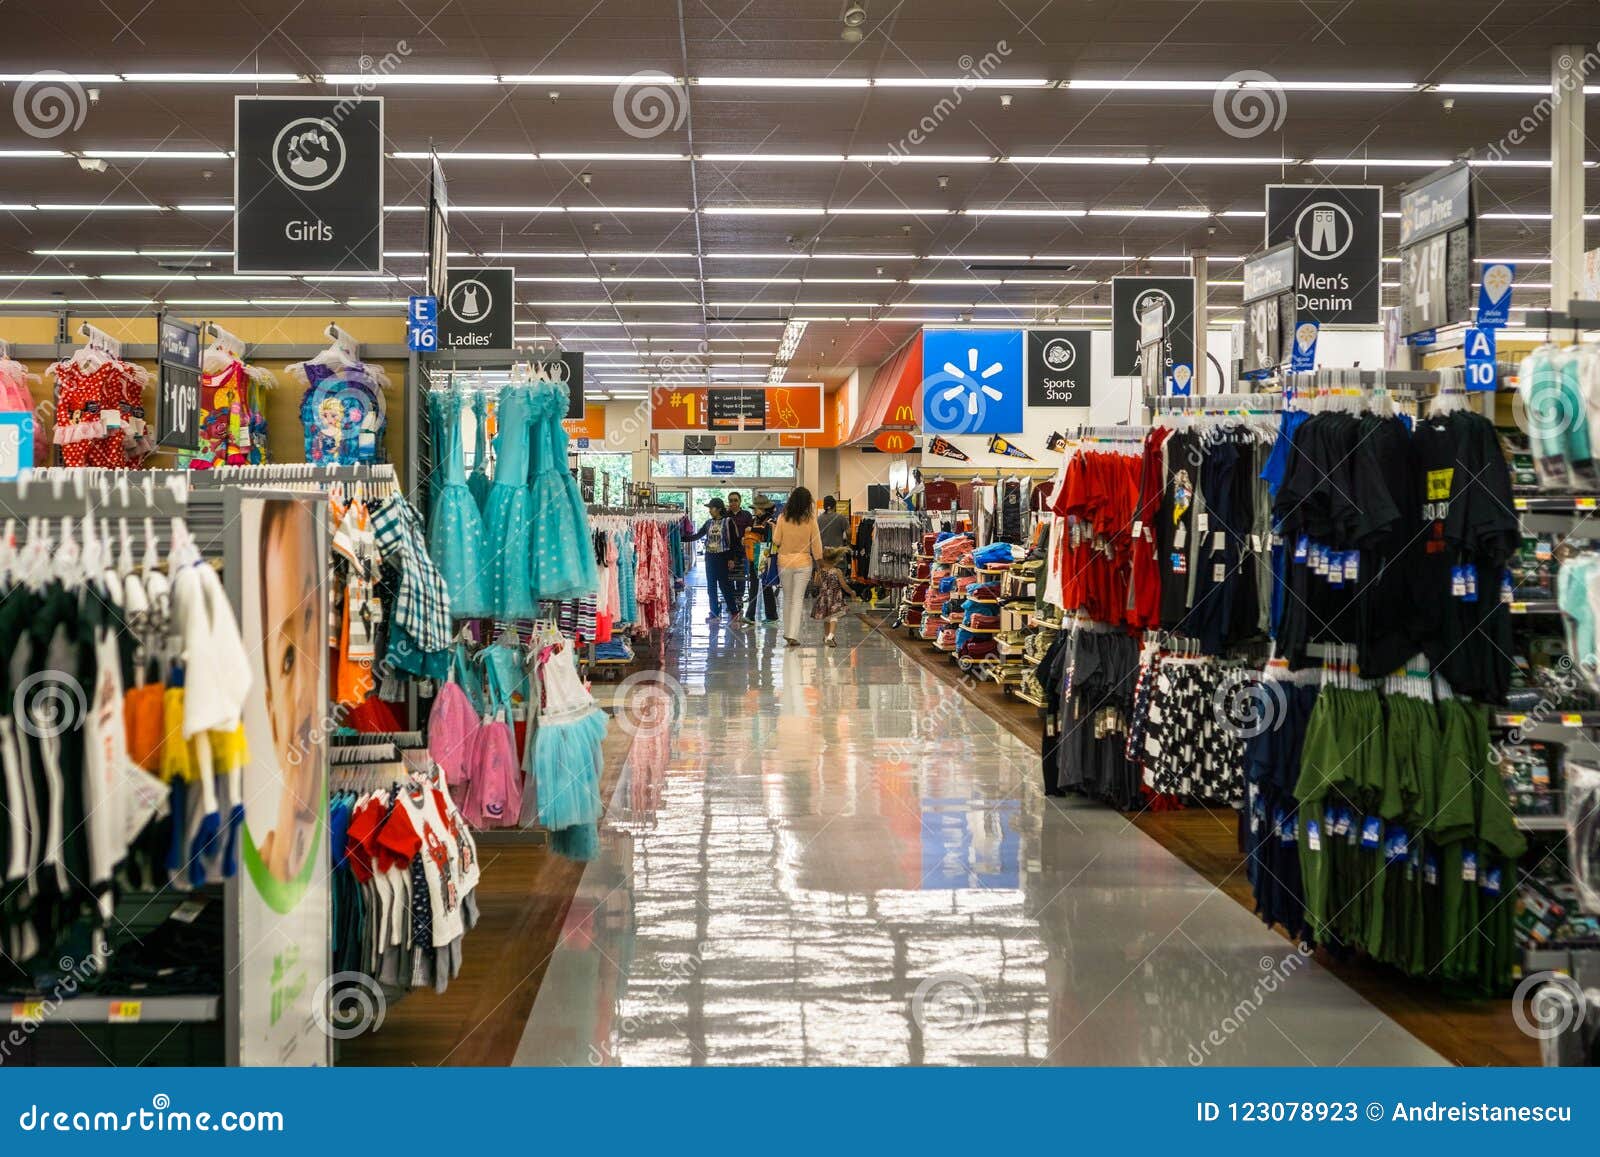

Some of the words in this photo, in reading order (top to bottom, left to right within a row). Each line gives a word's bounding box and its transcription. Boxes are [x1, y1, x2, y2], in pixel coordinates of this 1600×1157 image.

[285, 220, 333, 244] Girls
[1299, 272, 1349, 290] Men's
[415, 299, 428, 320] E
[1296, 294, 1352, 311] Denim
[412, 328, 434, 347] 16
[448, 332, 493, 346] Ladies'
[1470, 332, 1491, 356] A
[1469, 363, 1494, 384] 10
[1043, 378, 1075, 390] Sports
[1046, 390, 1072, 402] Shop
[670, 392, 695, 425] #1
[564, 424, 589, 434] nline.
